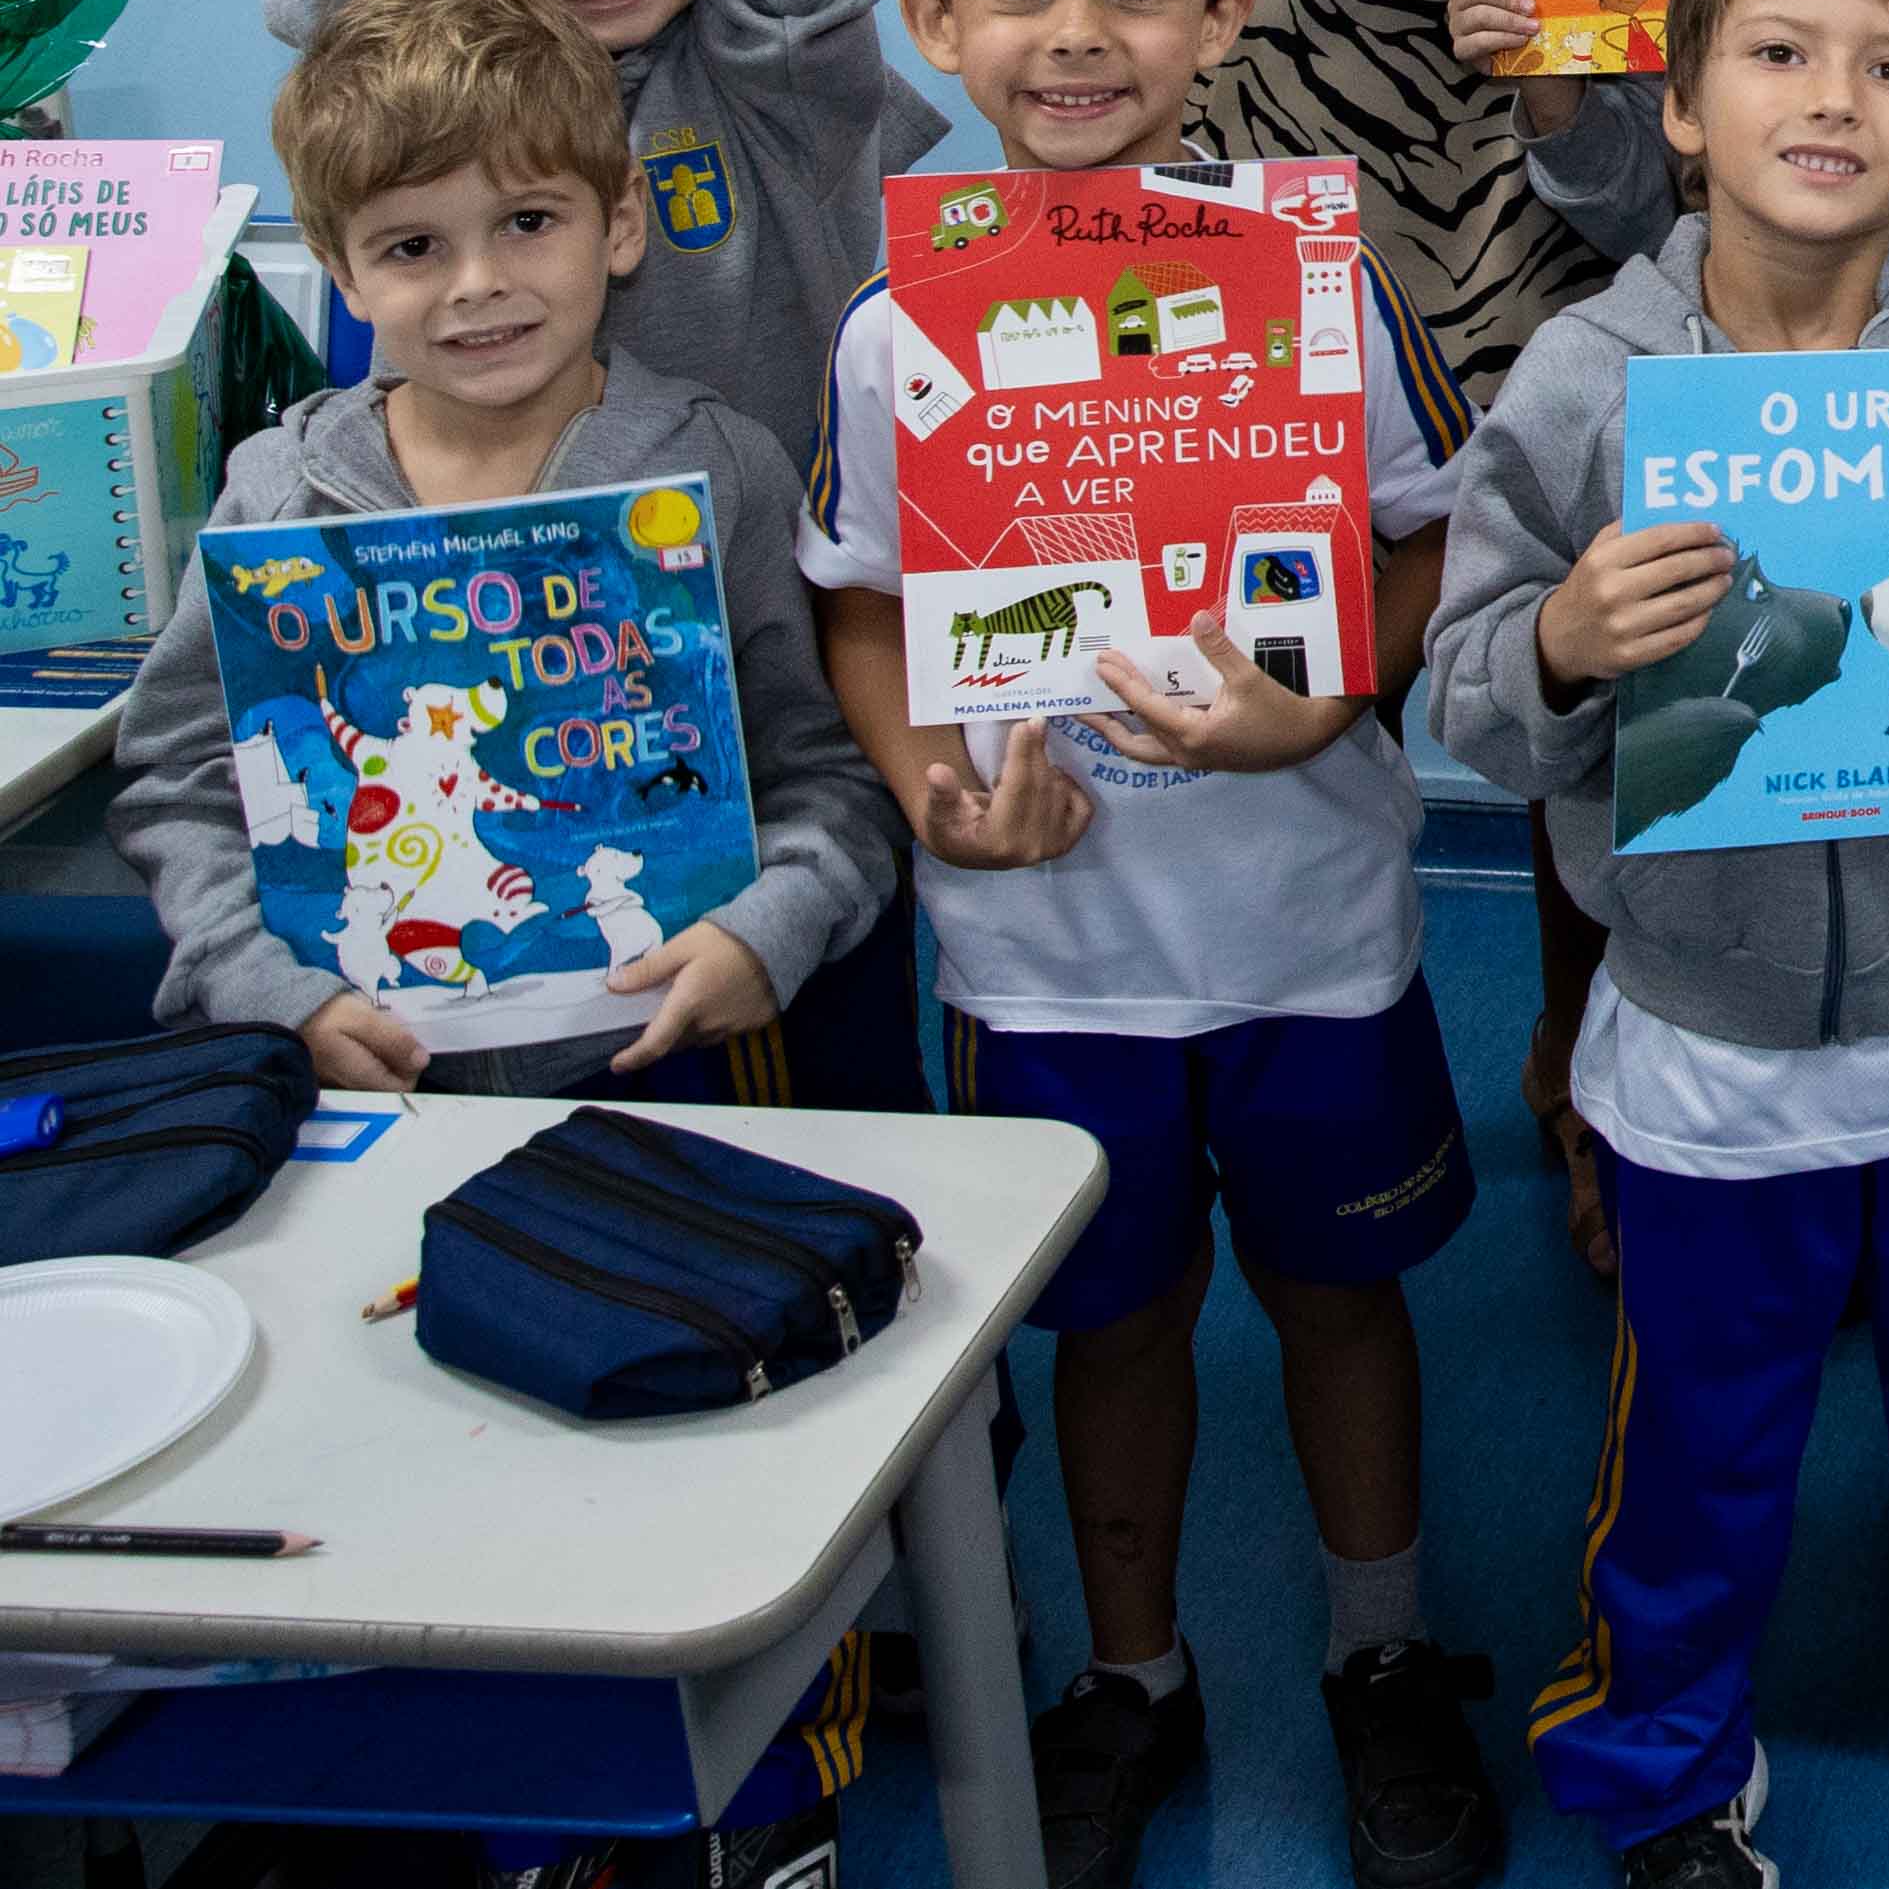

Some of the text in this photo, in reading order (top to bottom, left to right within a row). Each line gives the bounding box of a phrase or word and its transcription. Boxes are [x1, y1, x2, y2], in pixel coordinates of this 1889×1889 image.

[26, 149, 104, 168] Rocha
[7, 176, 130, 206] LÁPIS DE
[22, 205, 148, 237] SÓ MEUS
[1048, 203, 1243, 247] Ruth Rocha
[986, 404, 1015, 430] O
[1761, 392, 1798, 434] O
[967, 421, 1345, 482] que APRENDEU
[1015, 478, 1134, 508] A VER
[355, 522, 580, 564] STEPHEN MICHAEL KING
[269, 568, 606, 653] O URSO DE
[489, 608, 685, 691] TODAS
[604, 671, 651, 713] AS
[954, 696, 1092, 715] MADALENA MATOSO
[524, 704, 700, 777] CORES
[1766, 771, 1825, 794] NICK
